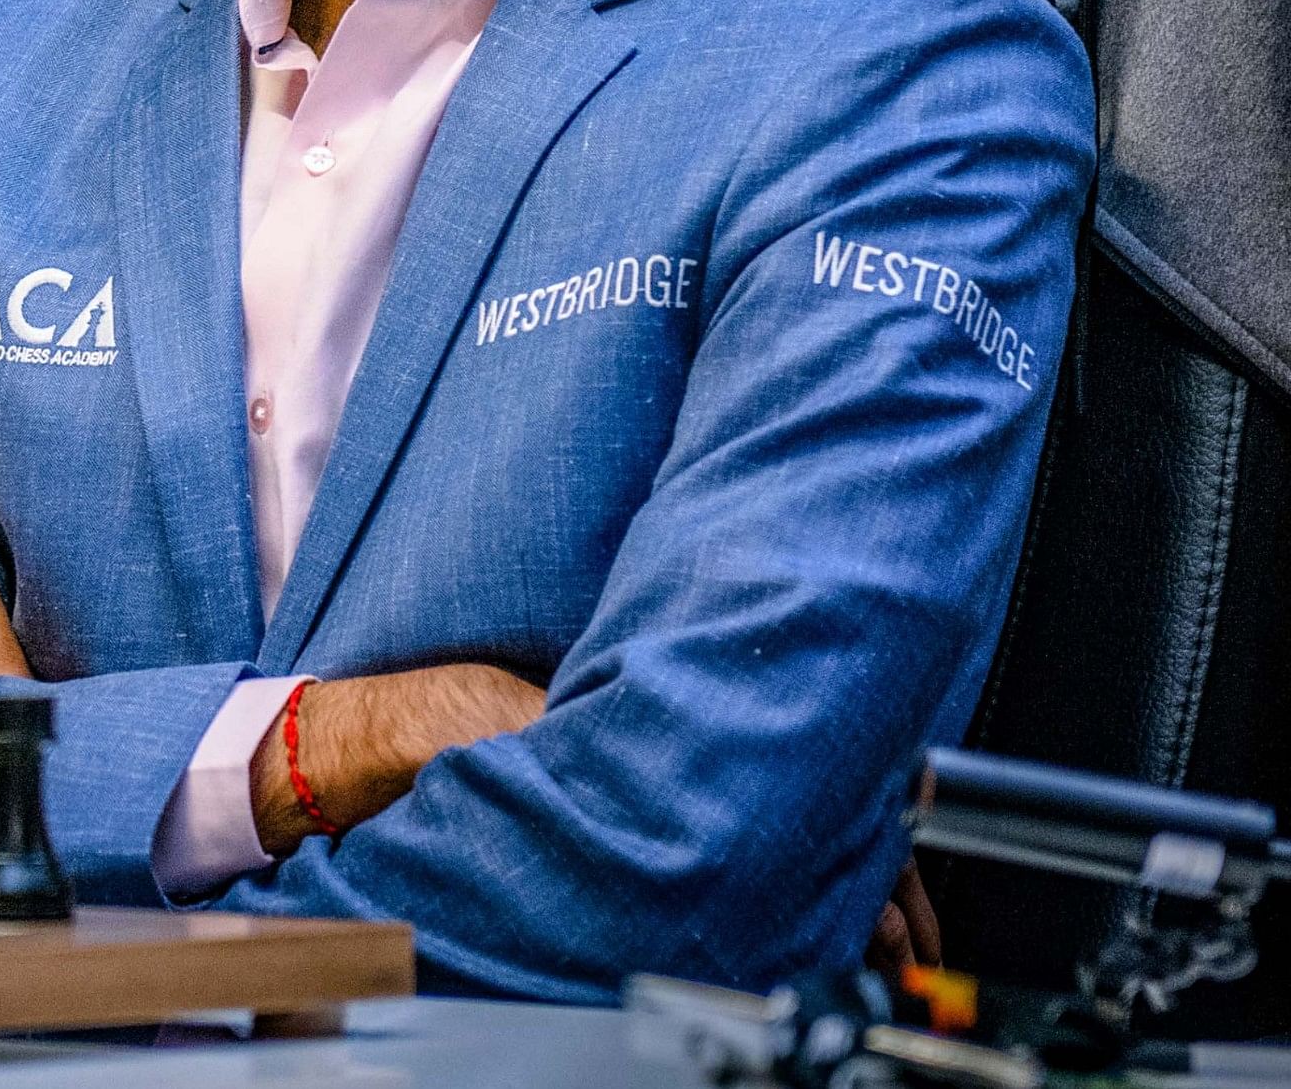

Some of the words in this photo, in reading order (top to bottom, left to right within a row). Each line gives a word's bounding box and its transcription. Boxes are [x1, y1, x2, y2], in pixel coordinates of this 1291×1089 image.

[475, 255, 698, 347] WESTBRIDGE
[813, 230, 1036, 391] WESTBRIDGE
[6, 345, 51, 364] CHESS
[50, 349, 119, 367] ACADEMY
